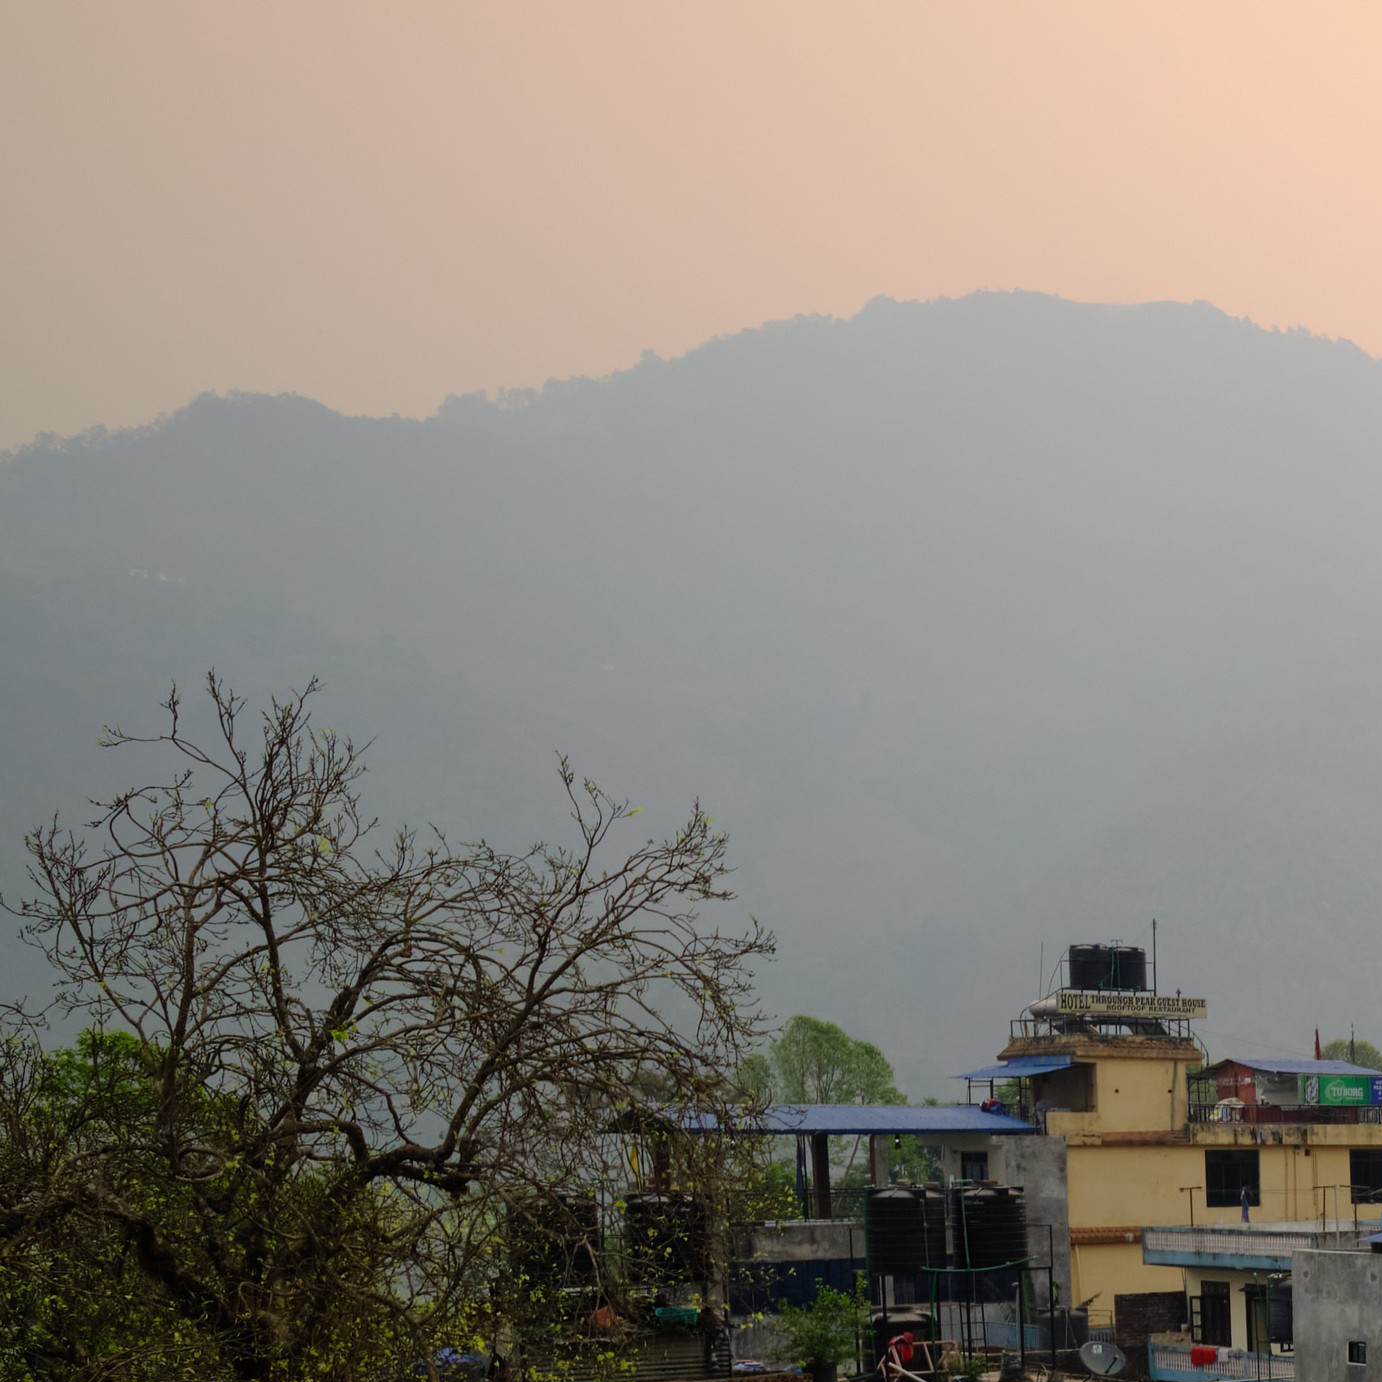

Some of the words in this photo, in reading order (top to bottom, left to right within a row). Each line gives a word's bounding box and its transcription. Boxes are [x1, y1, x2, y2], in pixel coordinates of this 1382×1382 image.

[1061, 994, 1090, 1009] HOTEL
[1135, 996, 1155, 1006] PEAK
[1157, 997, 1180, 1007] GUEST
[1182, 998, 1206, 1008] HOUSE
[1149, 1006, 1196, 1014] RESTAURANT
[1331, 1086, 1364, 1097] TUBORG
